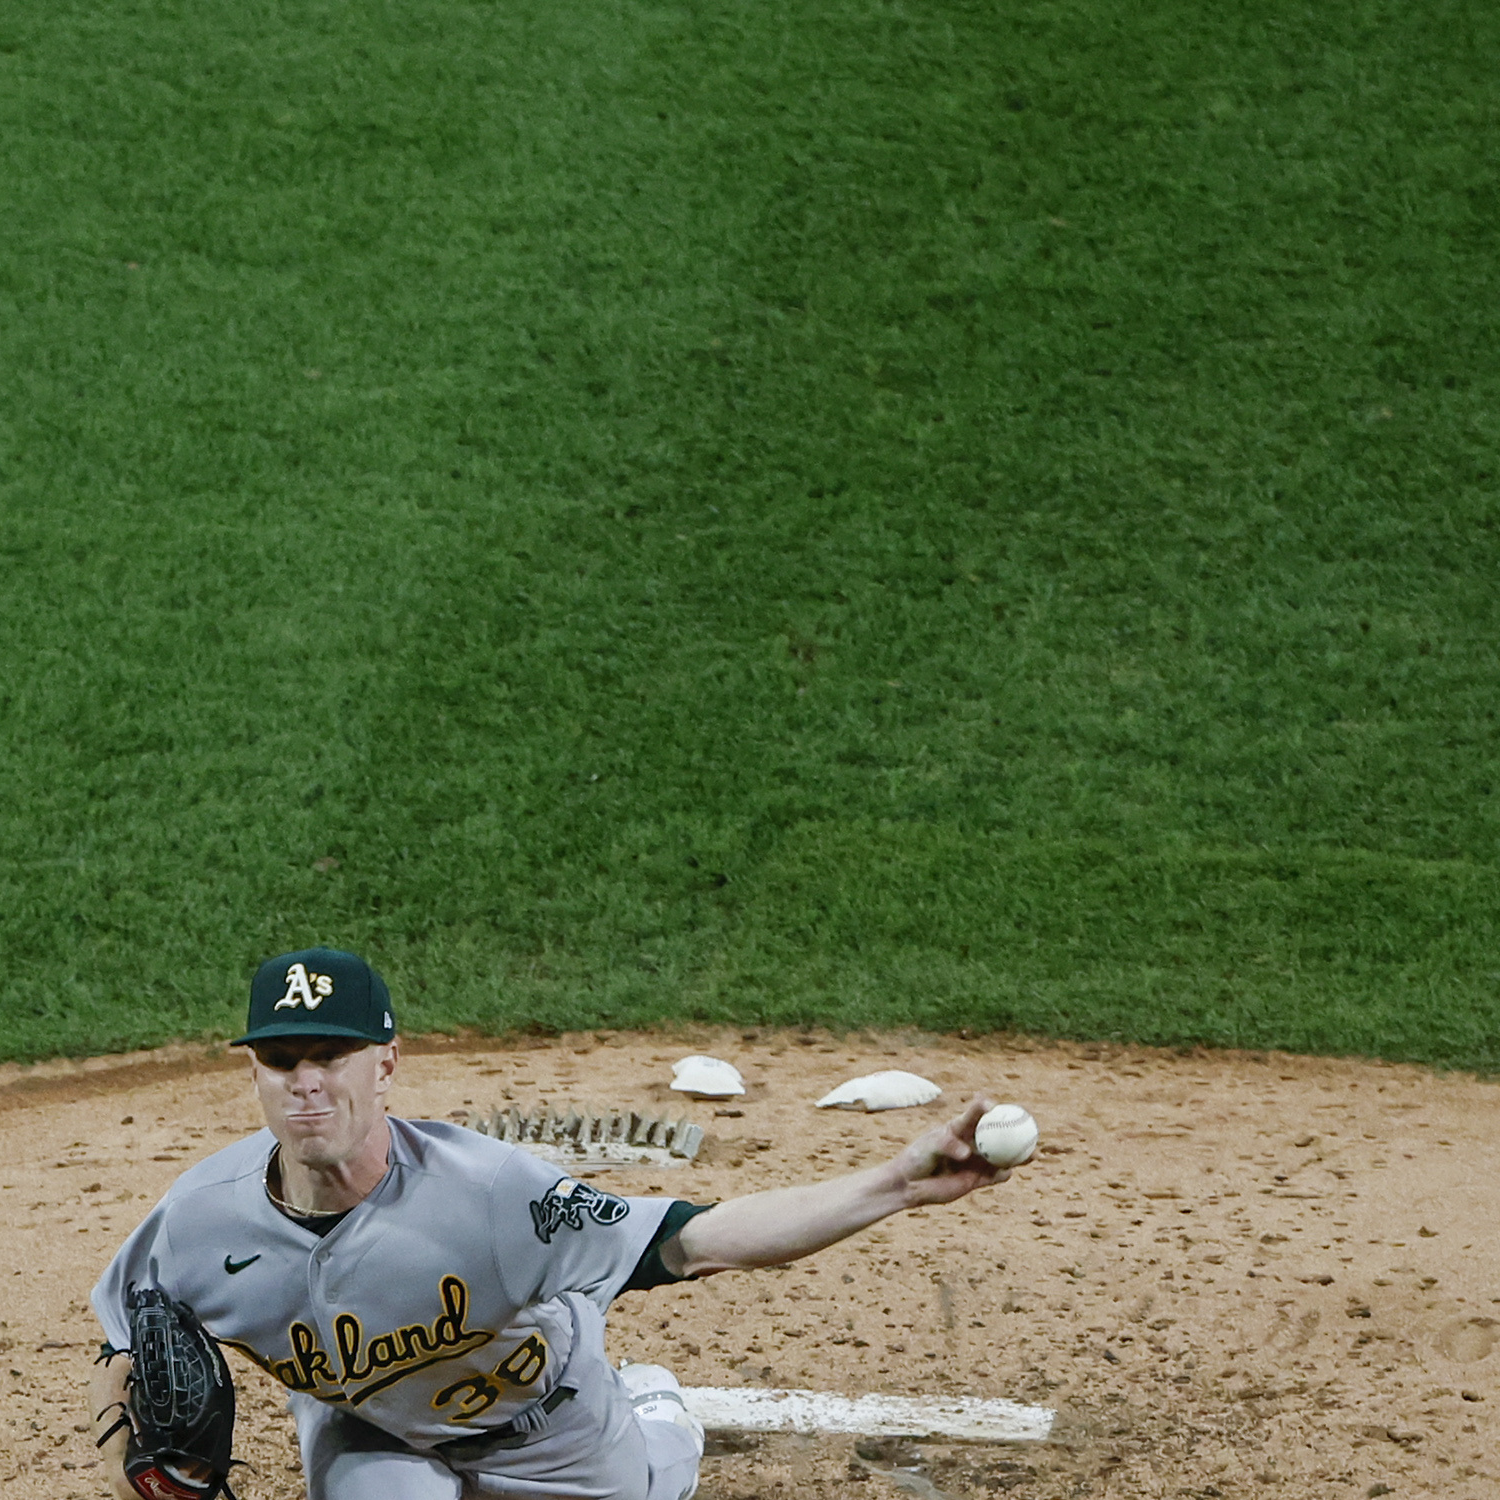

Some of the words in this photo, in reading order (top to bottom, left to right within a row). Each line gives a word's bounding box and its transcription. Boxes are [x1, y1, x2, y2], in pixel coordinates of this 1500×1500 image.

[273, 962, 334, 1012] A's
[266, 1273, 496, 1394] akland
[429, 1331, 549, 1422] 38
